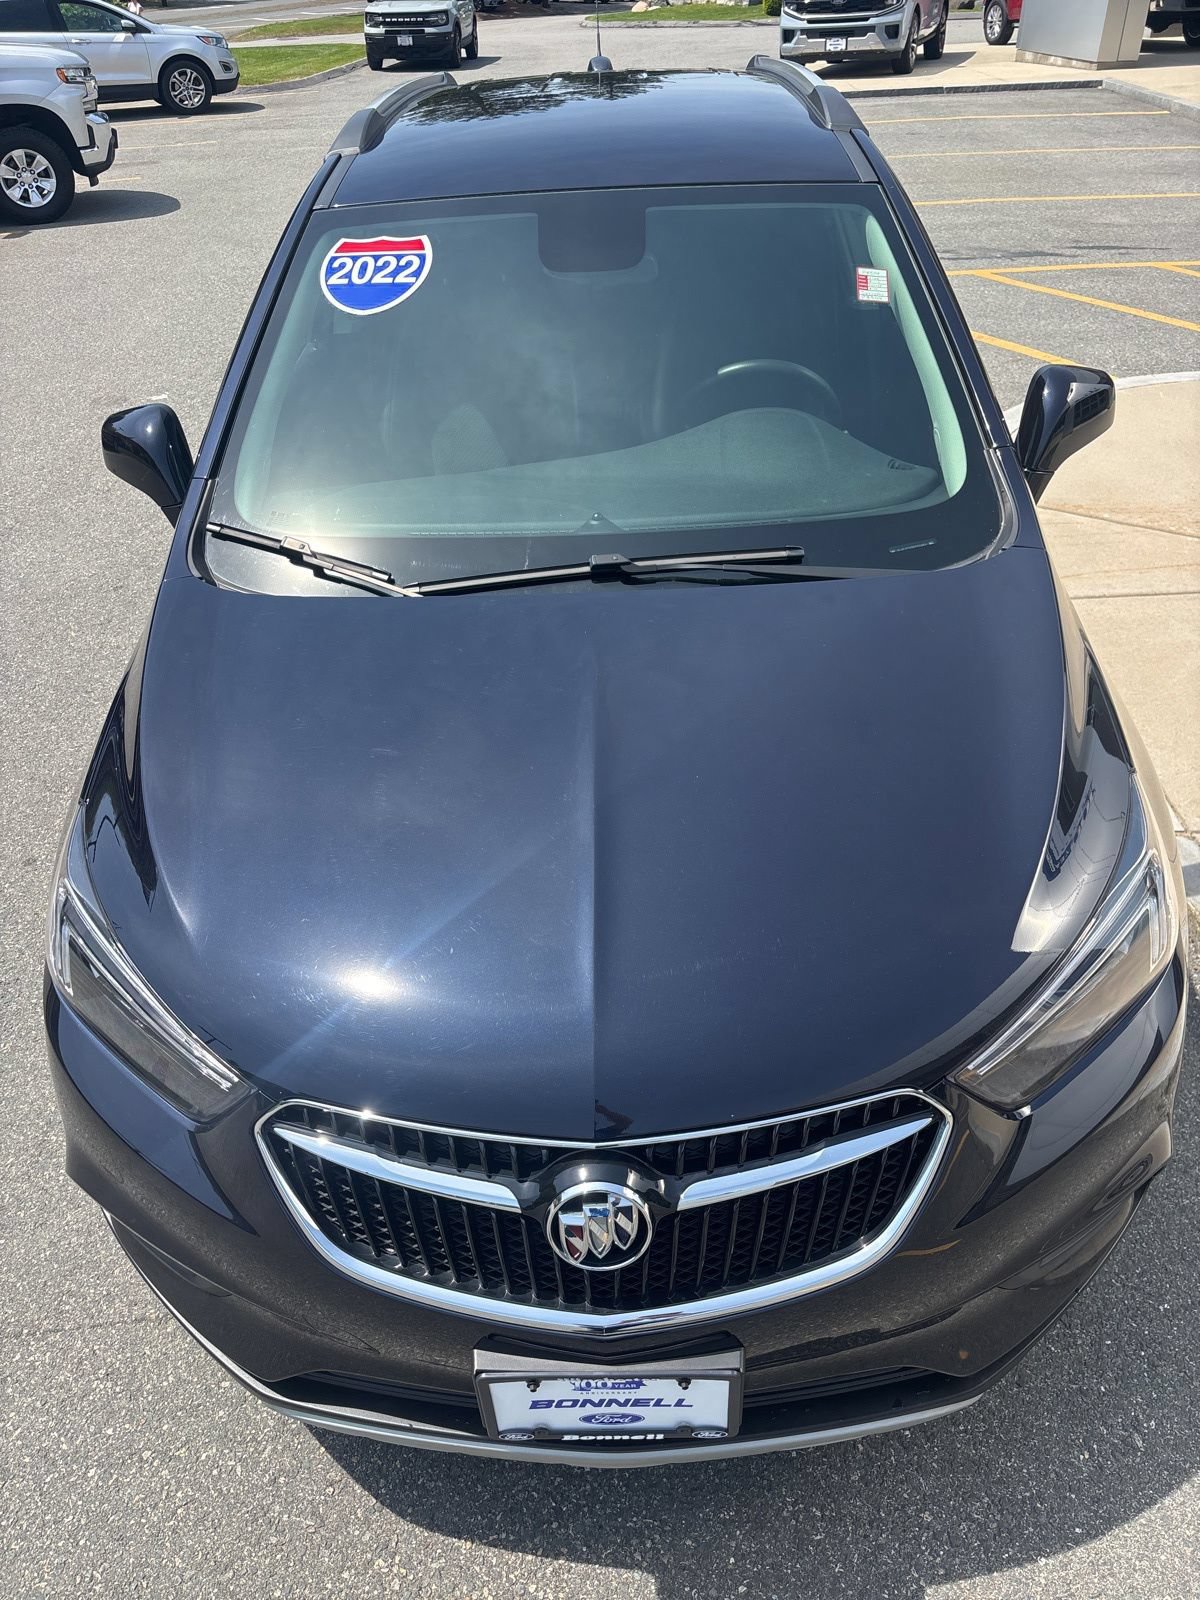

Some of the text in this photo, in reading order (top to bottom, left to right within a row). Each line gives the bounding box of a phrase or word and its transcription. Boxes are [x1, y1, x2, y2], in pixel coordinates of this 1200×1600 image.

[327, 255, 421, 285] 2022
[570, 1380, 613, 1391] 100
[529, 1398, 693, 1409] BONNELL
[591, 1413, 633, 1423] Ford
